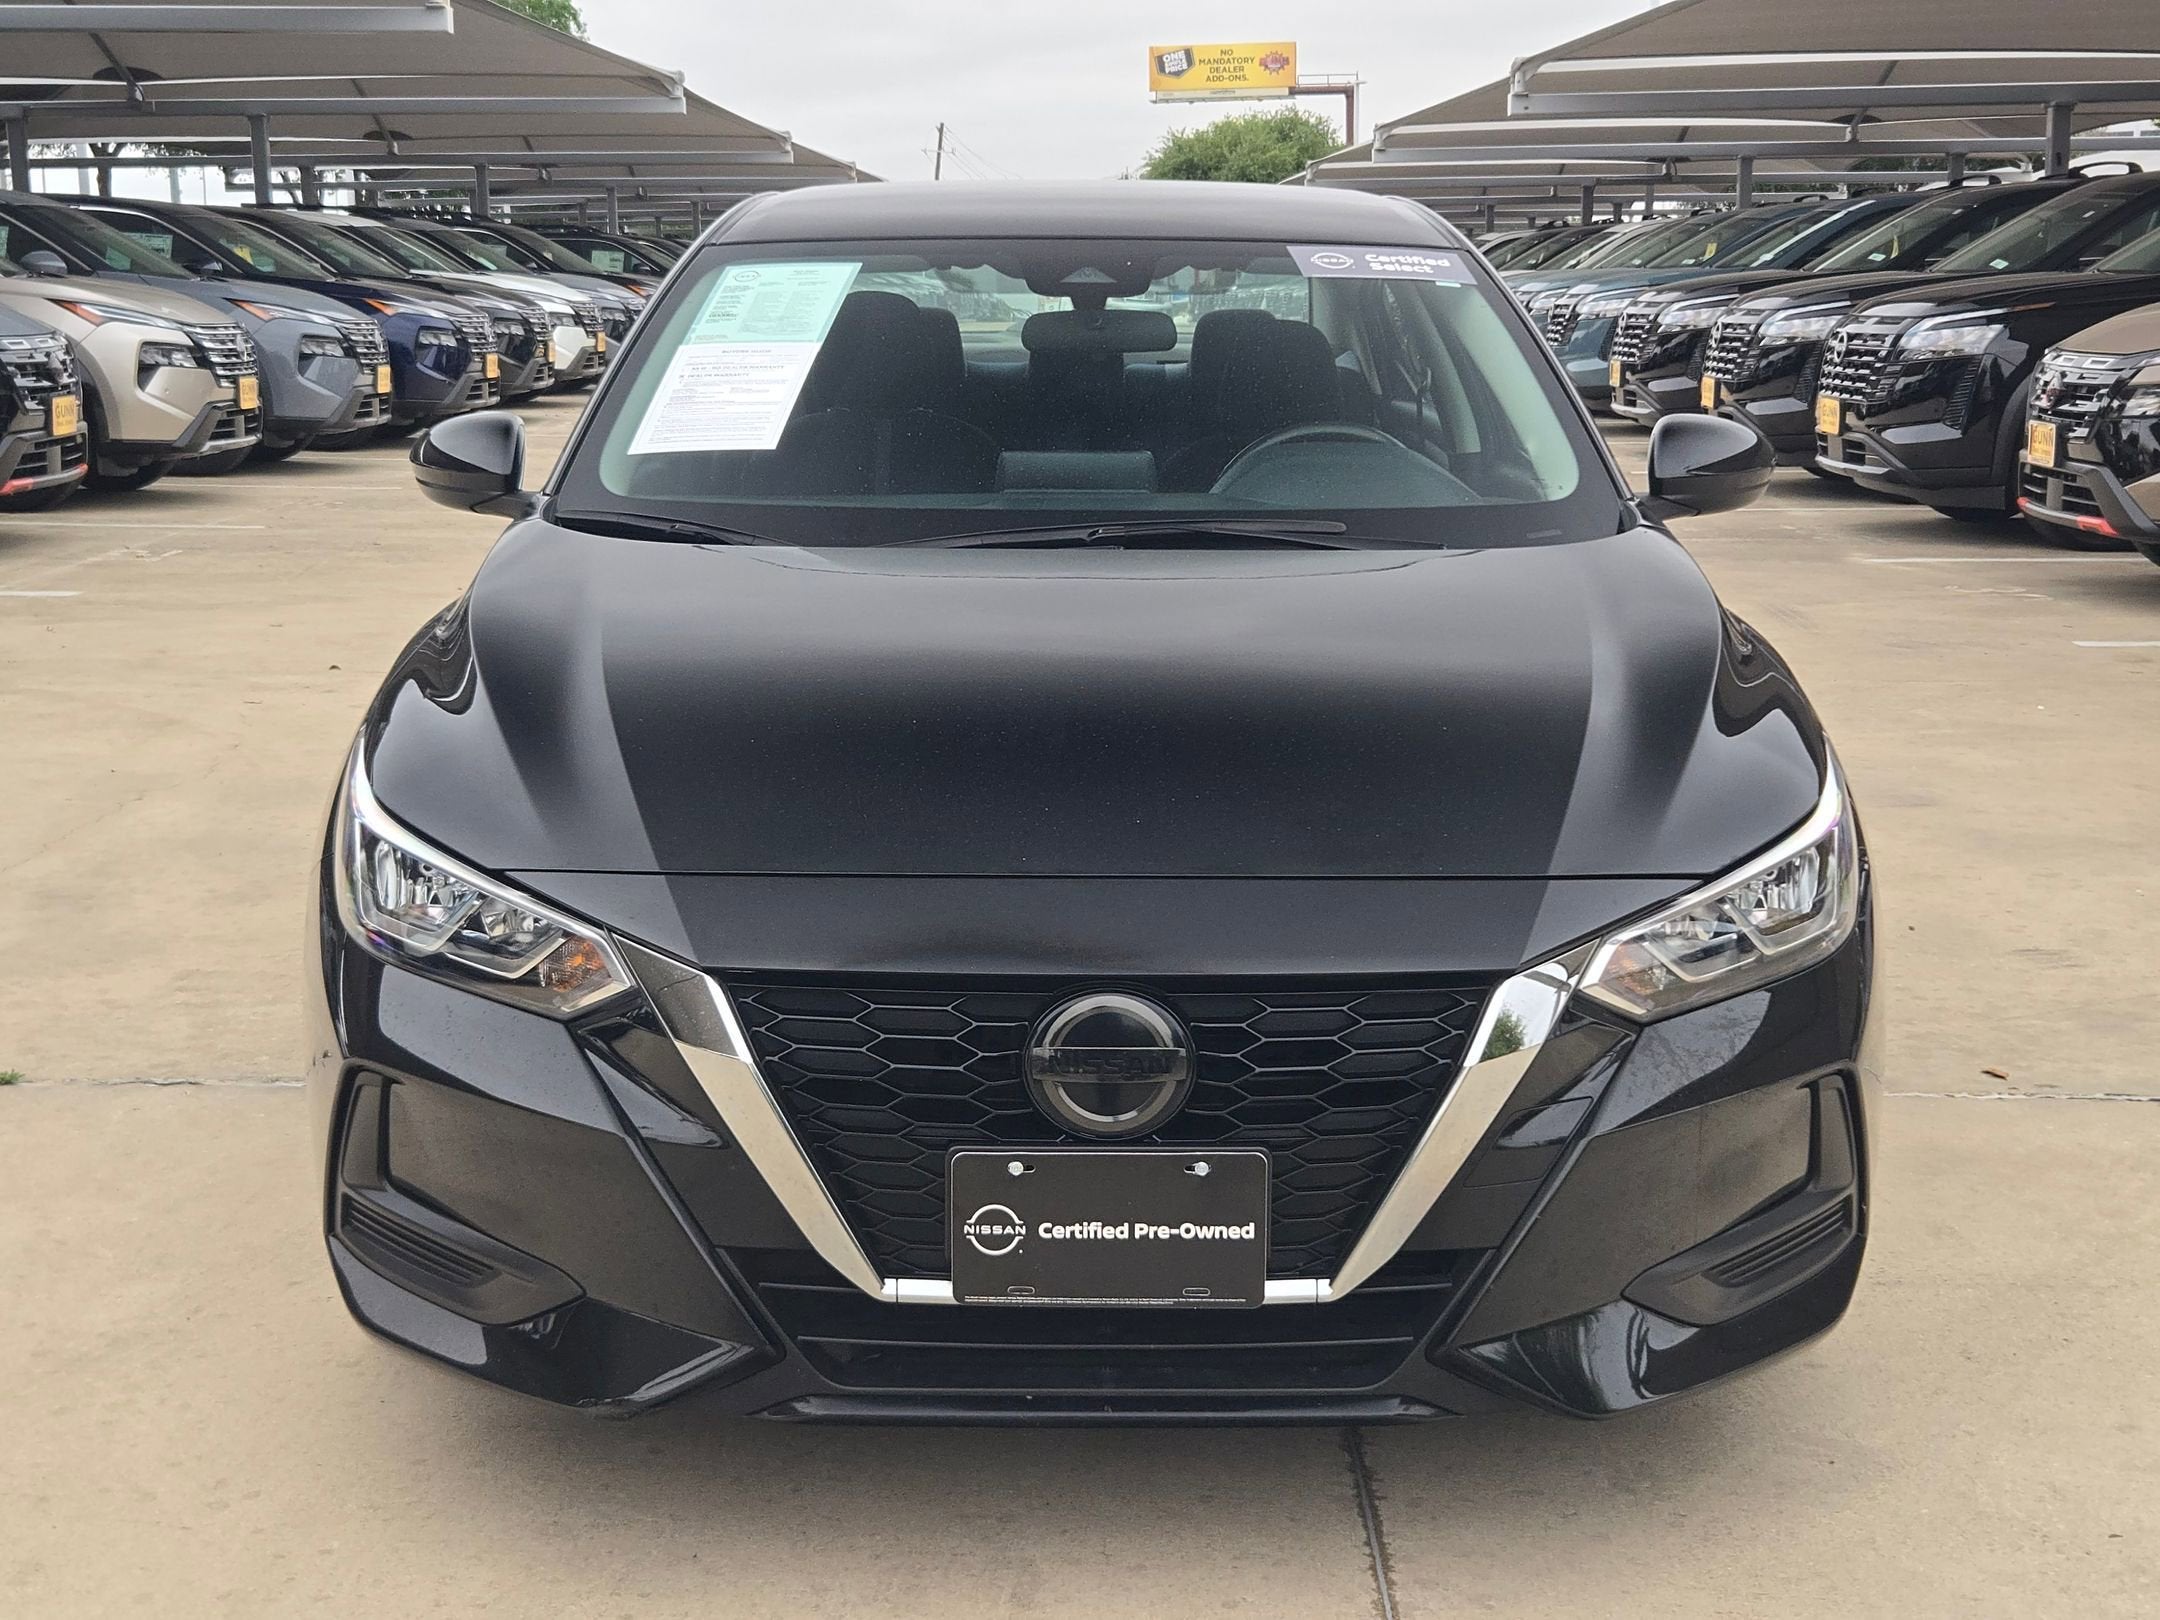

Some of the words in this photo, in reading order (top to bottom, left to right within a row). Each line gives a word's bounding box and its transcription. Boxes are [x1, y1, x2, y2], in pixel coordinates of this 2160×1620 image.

[1163, 50, 1185, 62] ONE
[1199, 57, 1255, 65] MANDATORY
[1209, 66, 1245, 74] DEALER
[1365, 254, 1450, 267] Certified
[1370, 262, 1434, 273] Select
[963, 1224, 1026, 1235] NISSAN
[1038, 1222, 1129, 1240] Certified
[1134, 1222, 1255, 1240] Pre-Owned
